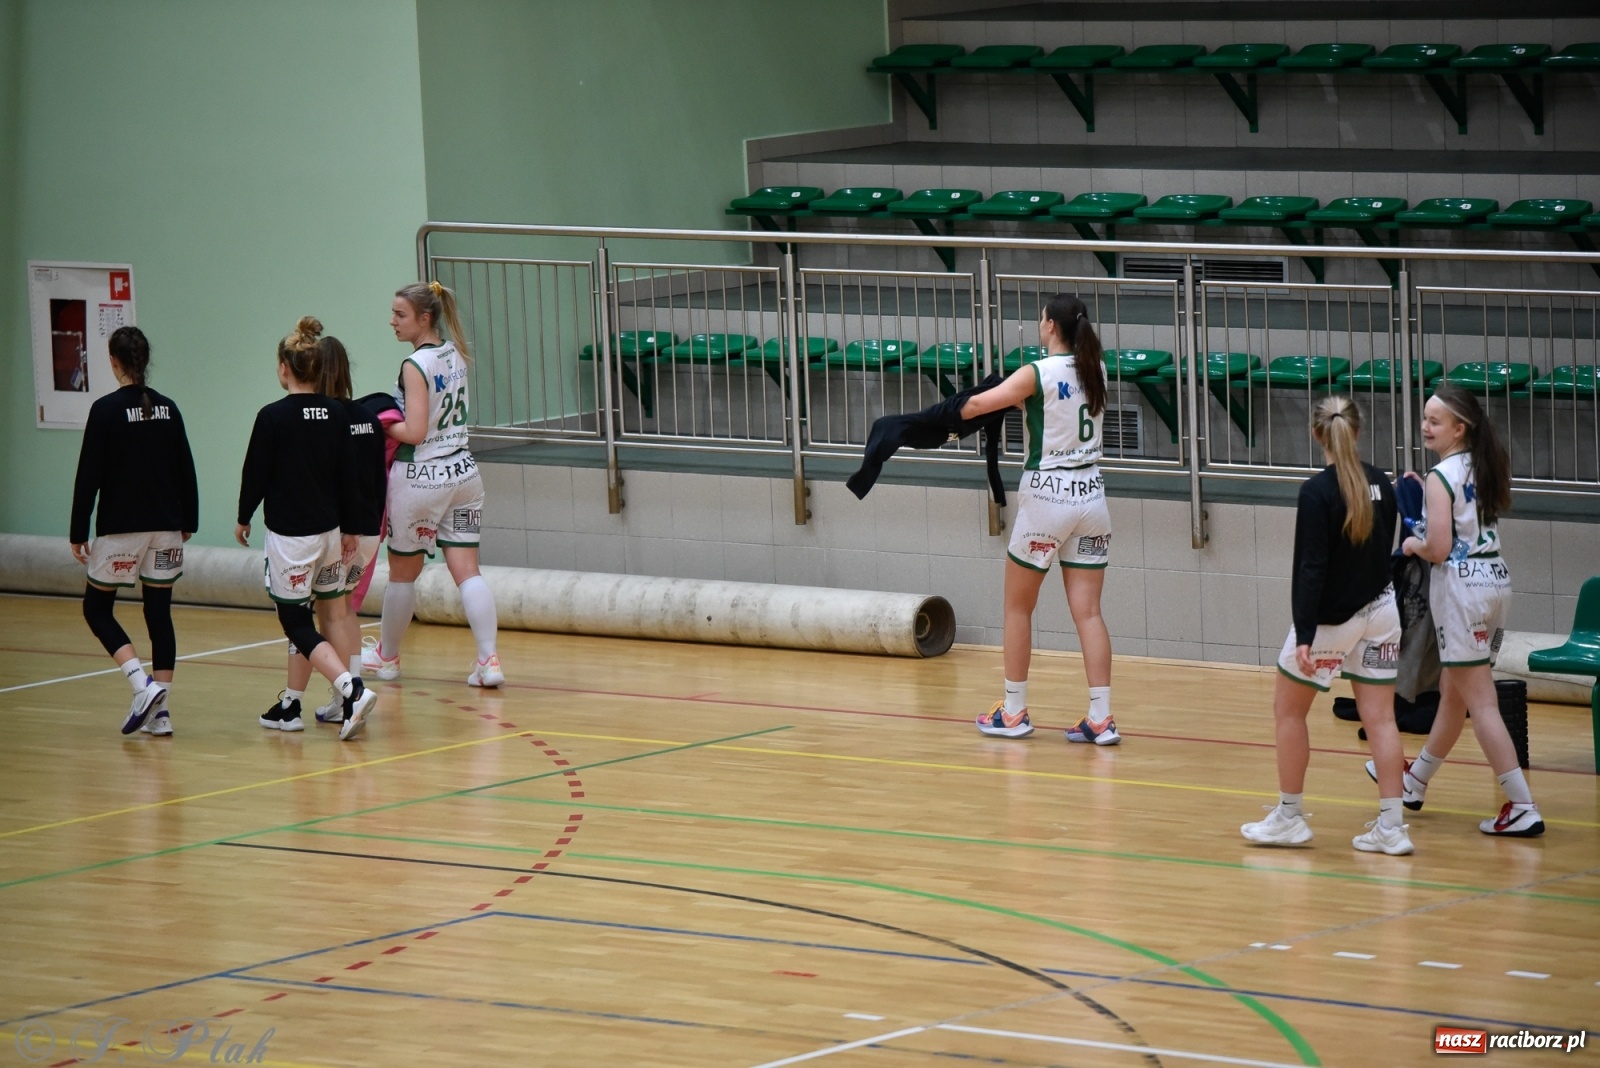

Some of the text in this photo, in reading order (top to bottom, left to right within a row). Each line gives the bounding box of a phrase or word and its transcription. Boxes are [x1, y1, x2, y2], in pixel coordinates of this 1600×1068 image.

[303, 407, 329, 420] STEC
[437, 387, 467, 431] 25
[1078, 403, 1094, 442] 6
